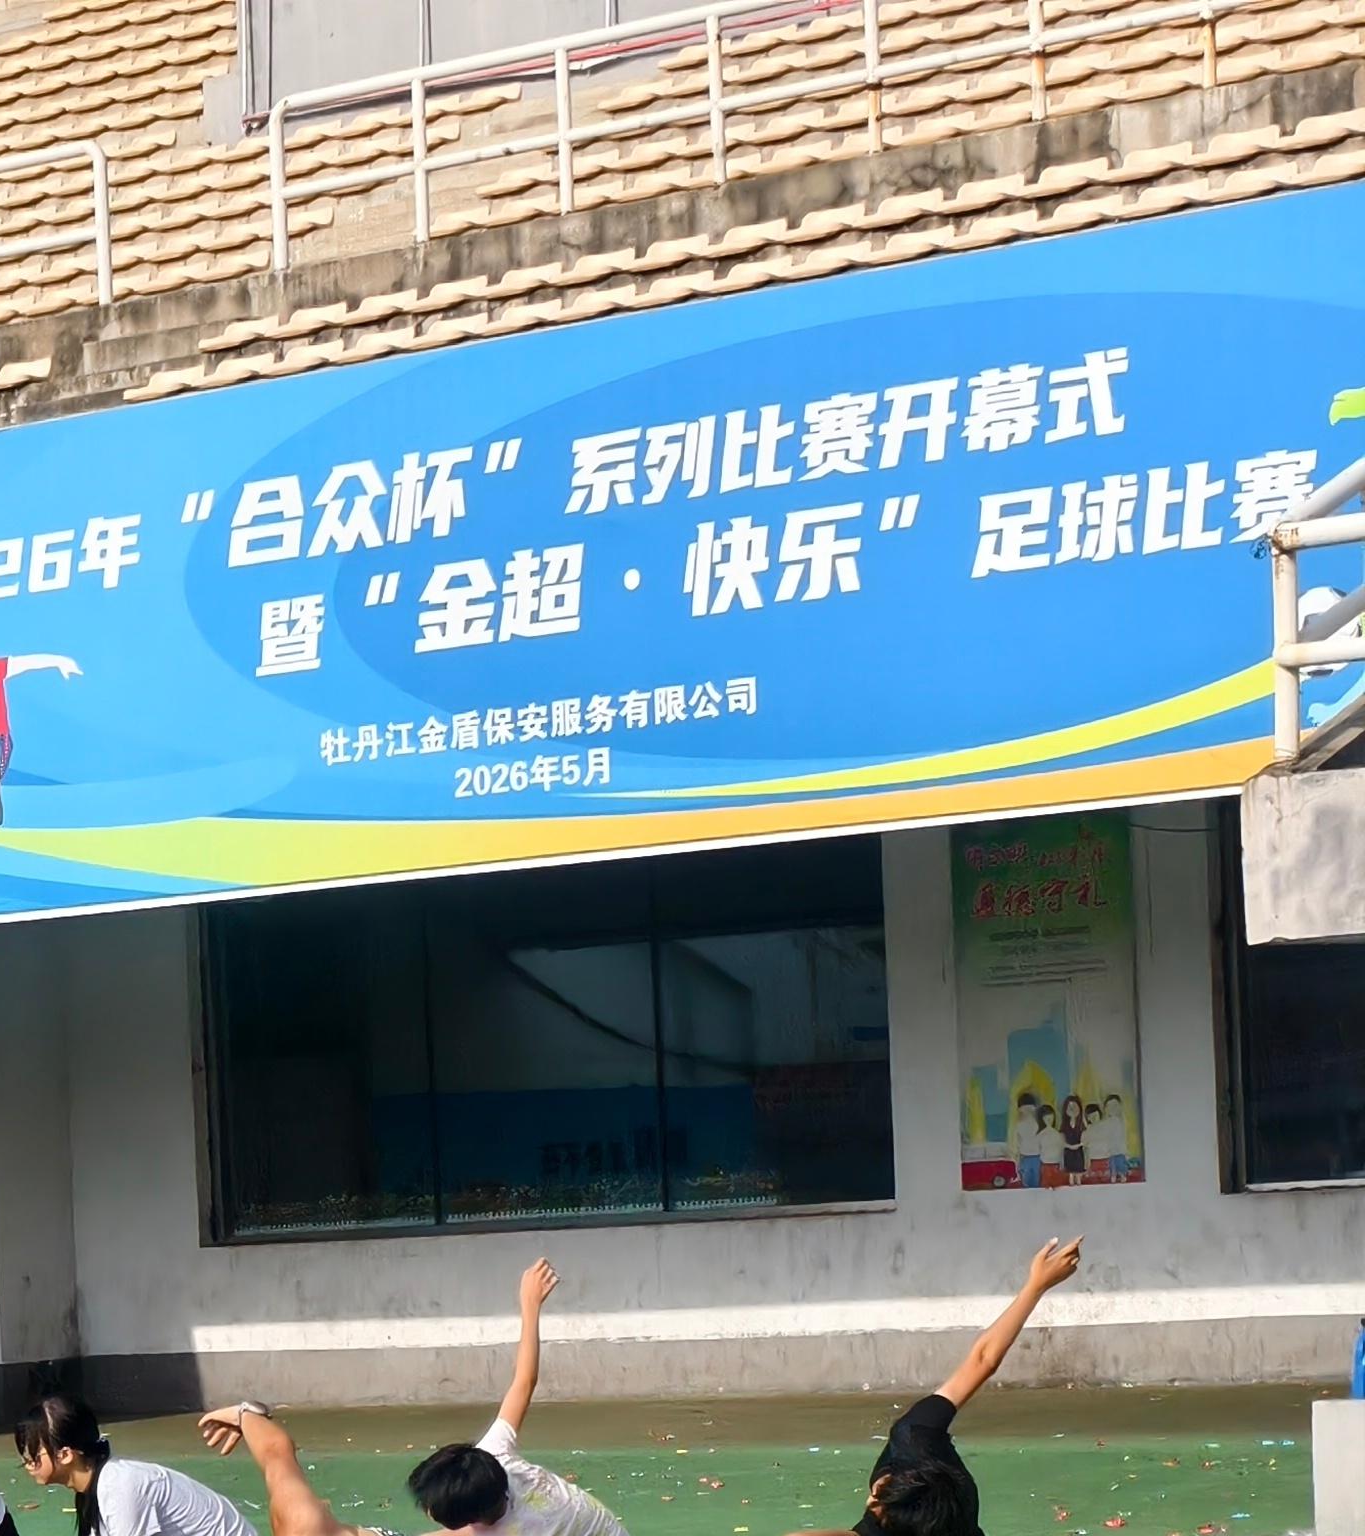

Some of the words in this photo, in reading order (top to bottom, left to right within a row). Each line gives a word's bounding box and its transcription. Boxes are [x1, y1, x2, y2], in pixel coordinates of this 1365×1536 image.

[564, 346, 1129, 516] 系列比赛开幕式
[255, 593, 325, 678] 暨
[971, 449, 1318, 579] 足球比赛
[319, 676, 758, 767] 牡丹江金盾保安服务有限公司
[454, 747, 611, 798] 2026年5月
